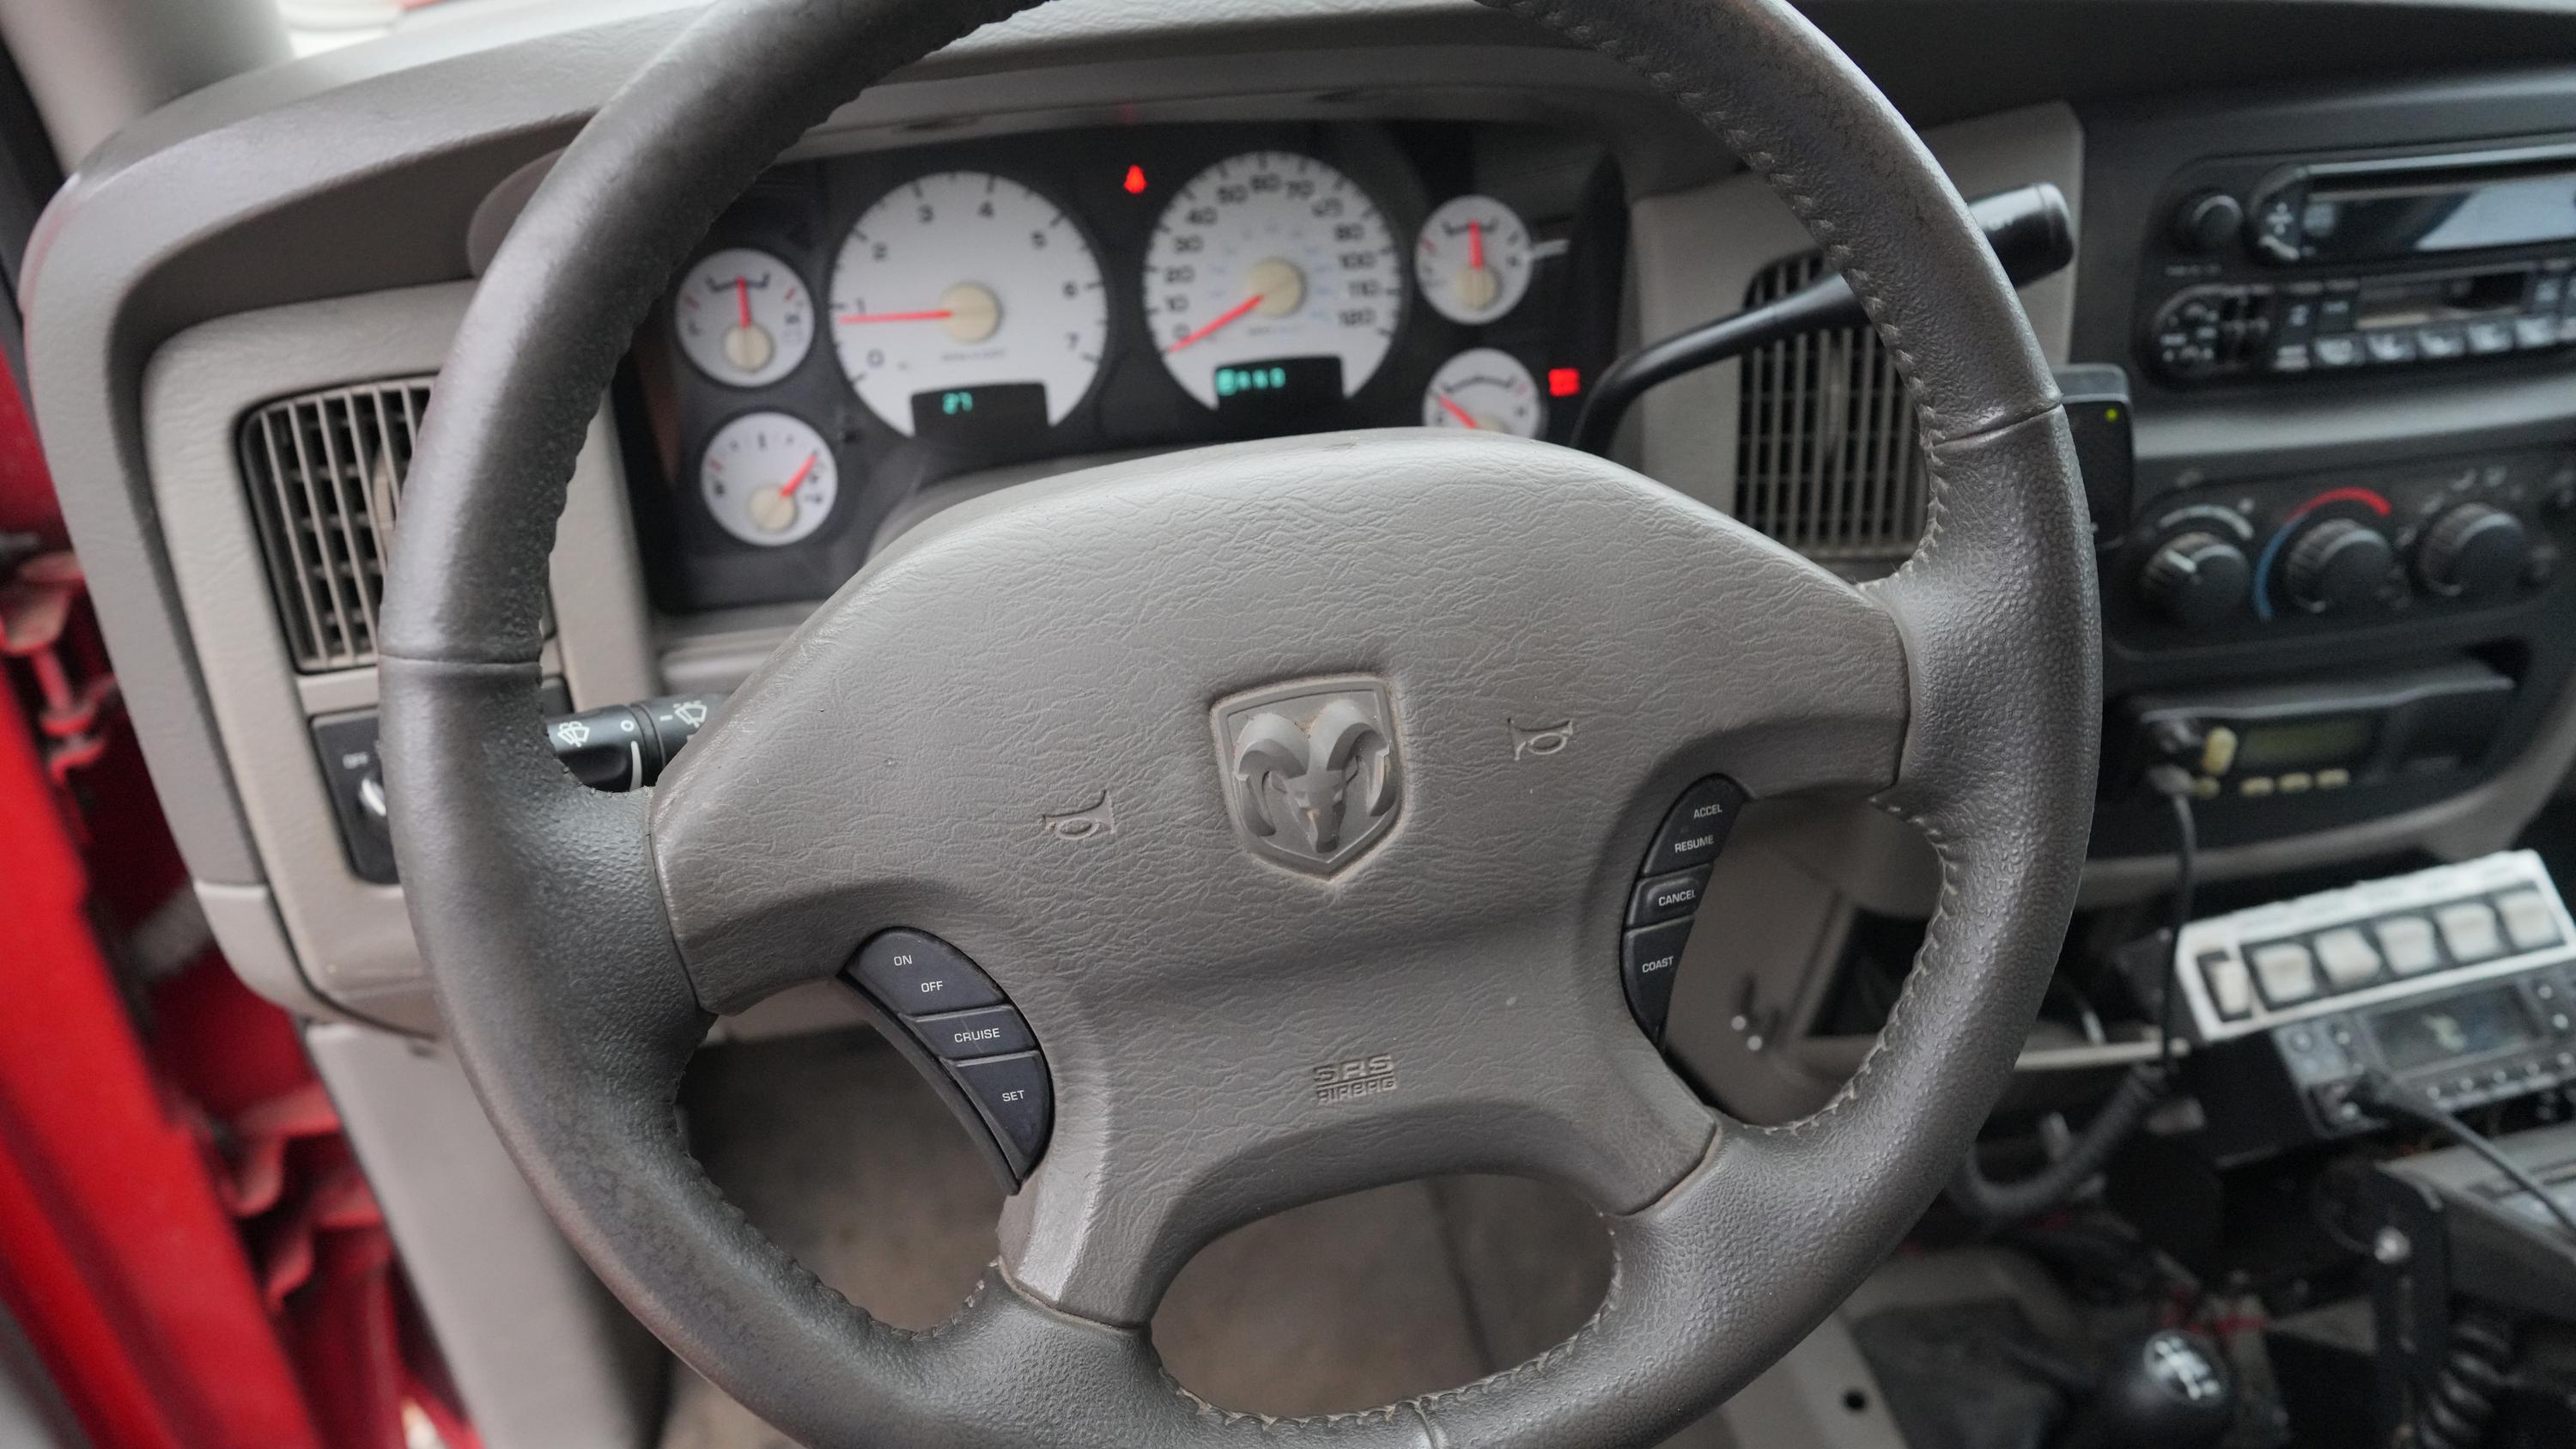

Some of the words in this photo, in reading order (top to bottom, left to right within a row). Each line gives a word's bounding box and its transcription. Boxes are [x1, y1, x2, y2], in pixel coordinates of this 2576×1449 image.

[1693, 804, 1722, 819] ACCEL
[1674, 835, 1715, 853] RESUME
[1658, 889, 1696, 906] CANCEL
[893, 954, 913, 966] ON
[1642, 956, 1674, 973] COAST
[920, 980, 944, 993] OFF
[954, 1027, 1001, 1043] CRUISE
[1312, 1053, 1394, 1082] SRS
[1002, 1089, 1025, 1102] SET
[1315, 1075, 1398, 1105] AIRBAG
